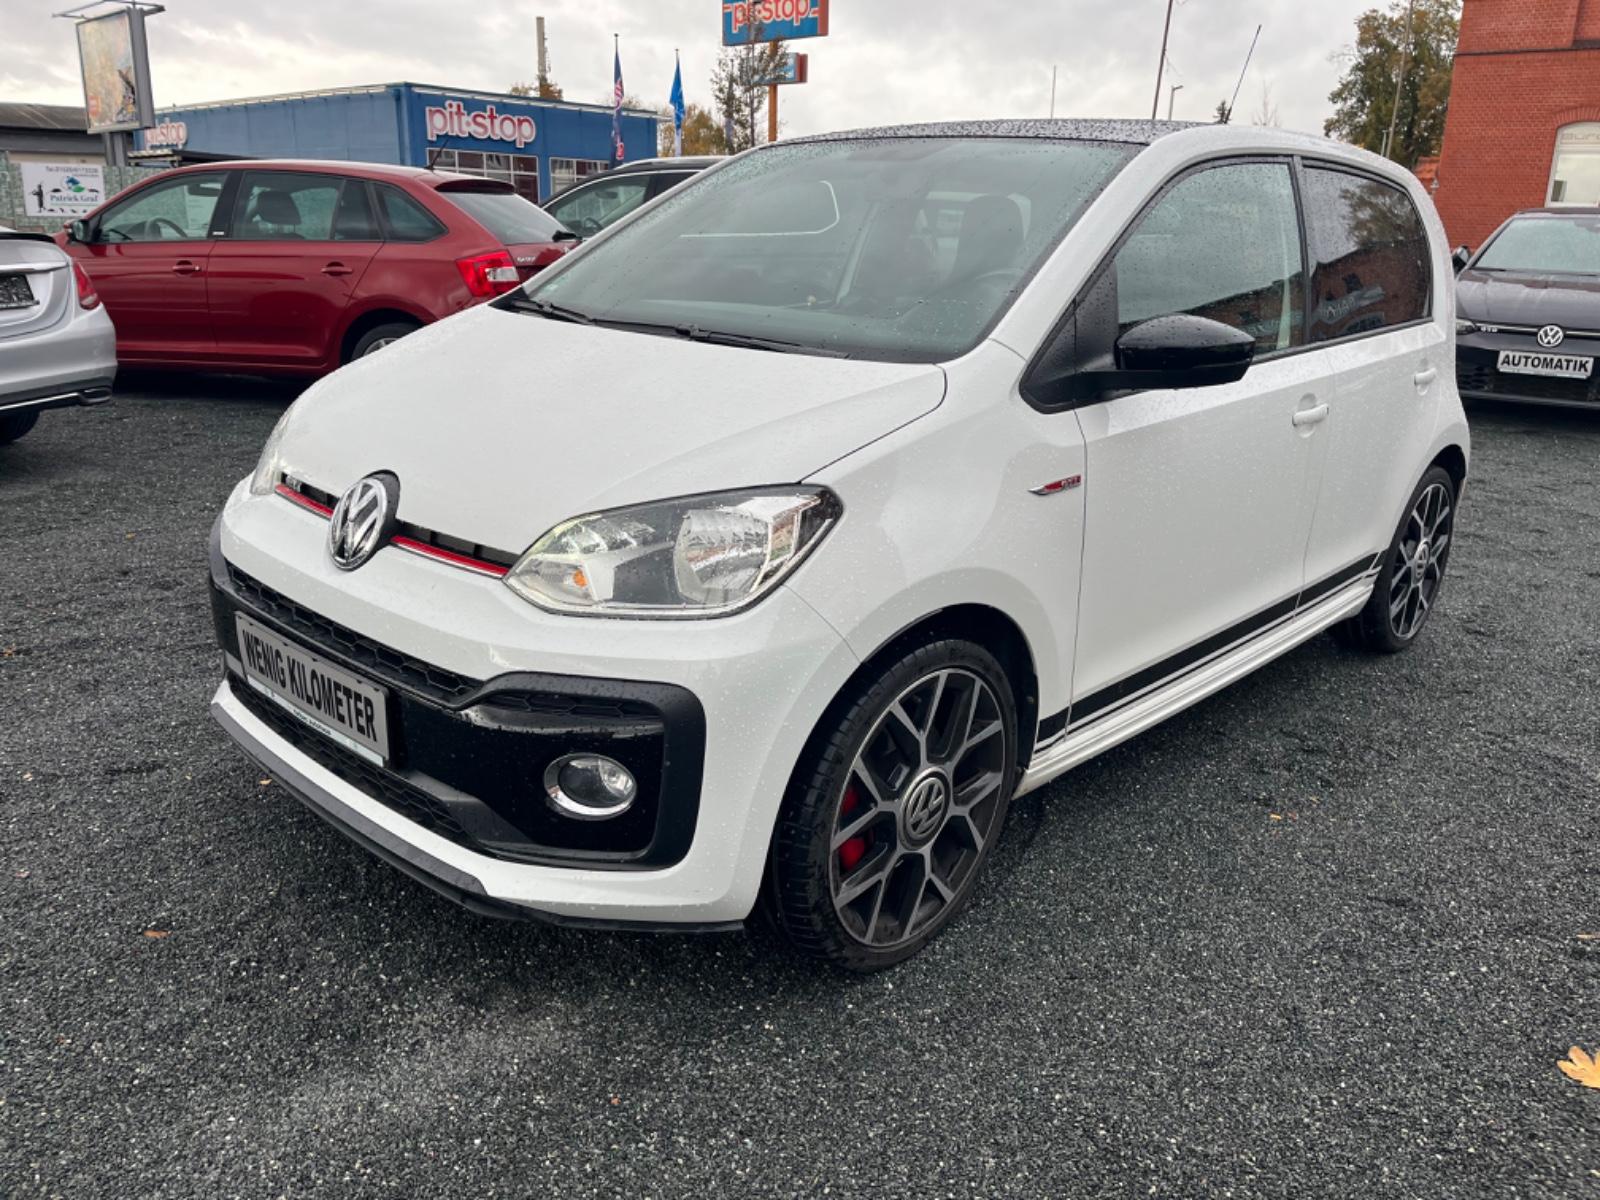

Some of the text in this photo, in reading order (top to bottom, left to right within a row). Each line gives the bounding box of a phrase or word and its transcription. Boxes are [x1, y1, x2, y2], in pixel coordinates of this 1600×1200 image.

[1500, 353, 1590, 373] AUTOMATIK
[242, 629, 378, 743] WENIG KILOMETER
